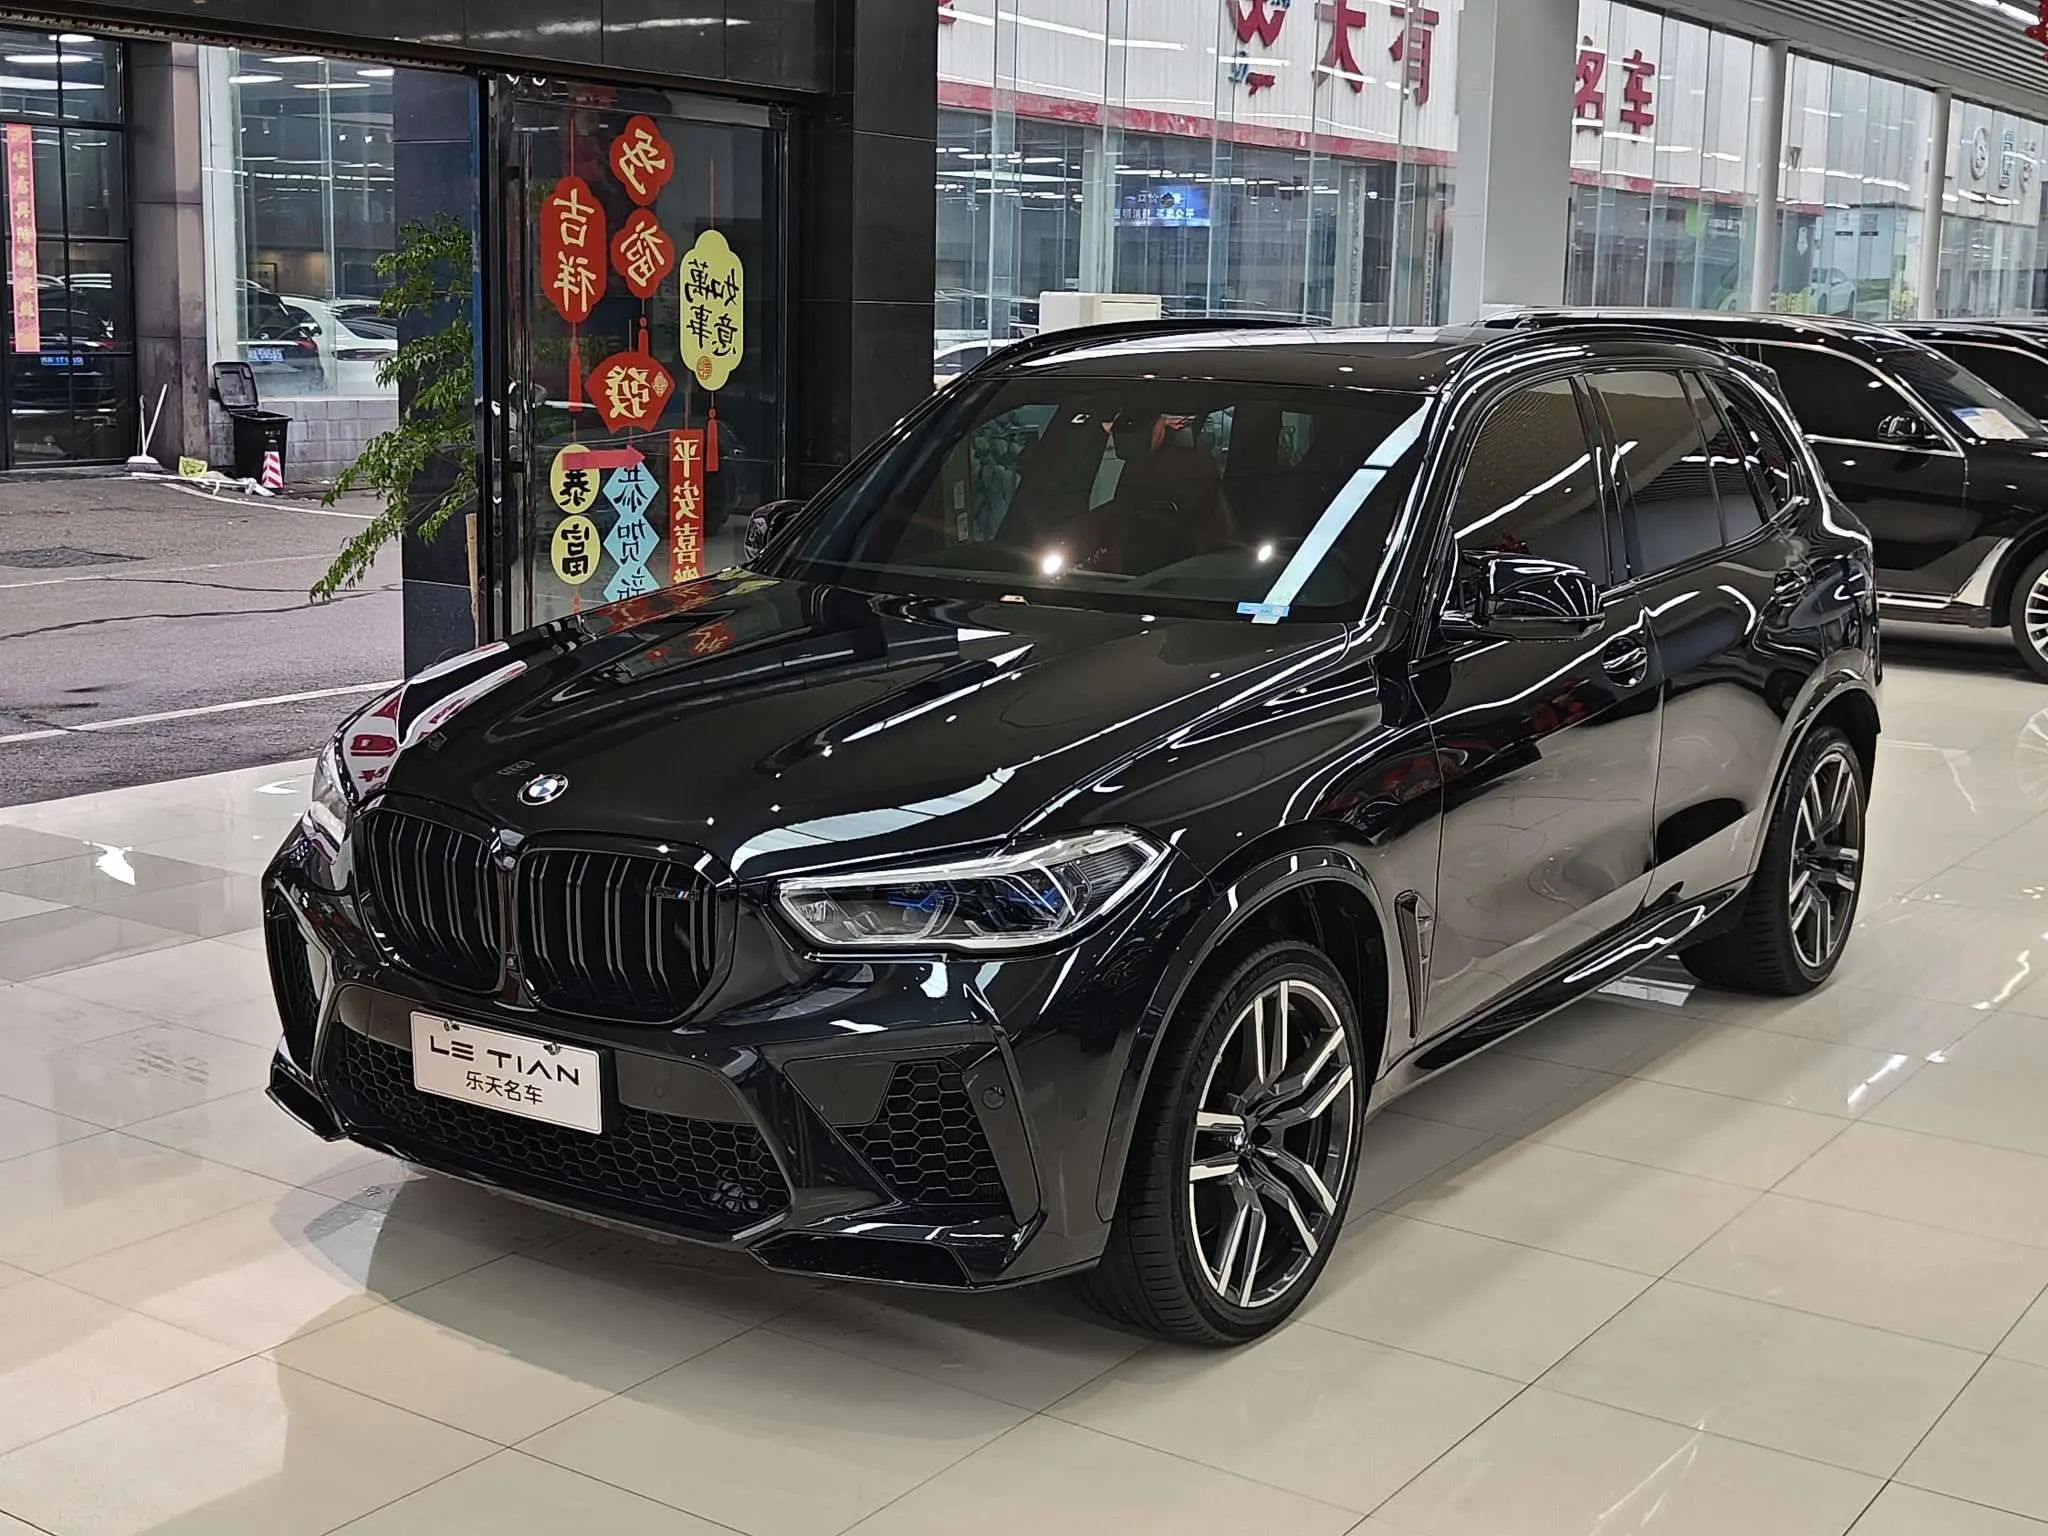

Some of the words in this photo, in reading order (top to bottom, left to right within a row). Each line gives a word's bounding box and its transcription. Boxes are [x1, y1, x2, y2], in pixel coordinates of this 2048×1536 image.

[429, 1034, 474, 1062] LE
[486, 1048, 580, 1086] TIAN
[465, 1070, 544, 1105] 乐天名车
